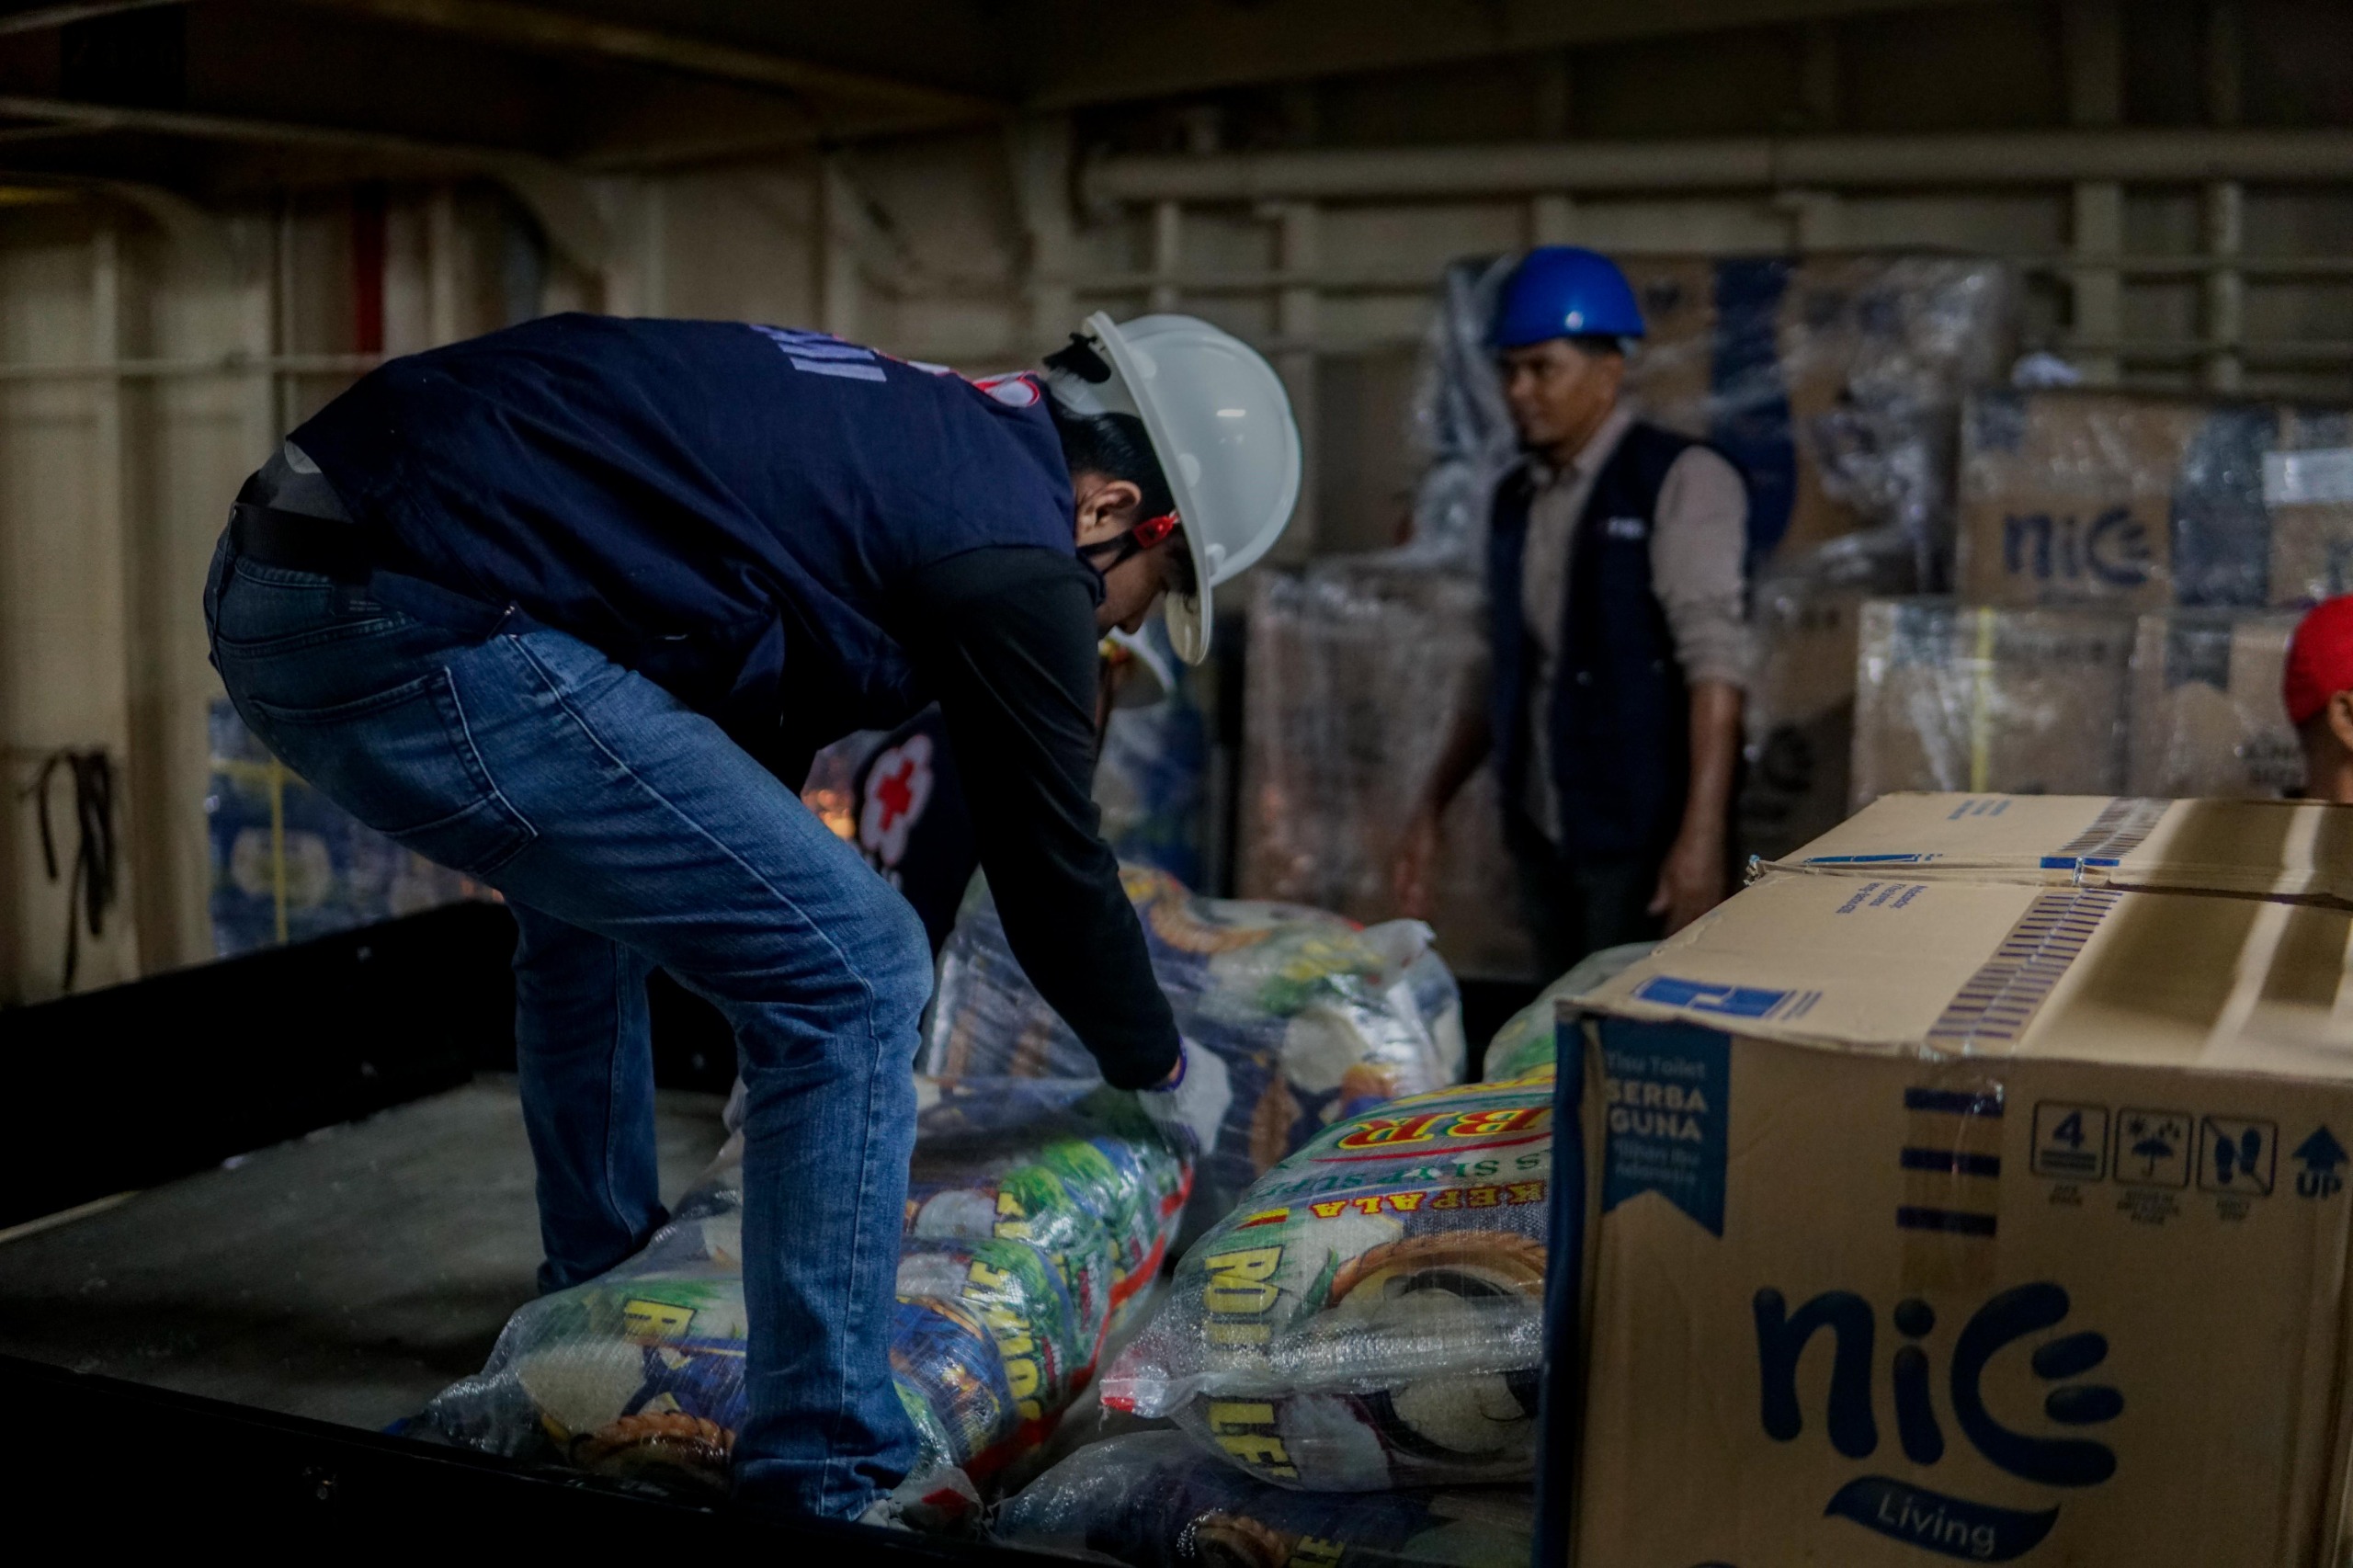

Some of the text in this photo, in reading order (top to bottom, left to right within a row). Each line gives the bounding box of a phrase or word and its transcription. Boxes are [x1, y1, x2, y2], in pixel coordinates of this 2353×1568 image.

[1605, 1076, 1710, 1115] SERBA
[1609, 1106, 1704, 1145] GUNA
[2052, 1110, 2085, 1149] 4
[1308, 1179, 1546, 1219] KEPALA
[2296, 1172, 2343, 1199] UP
[1877, 1490, 1997, 1558] Living
